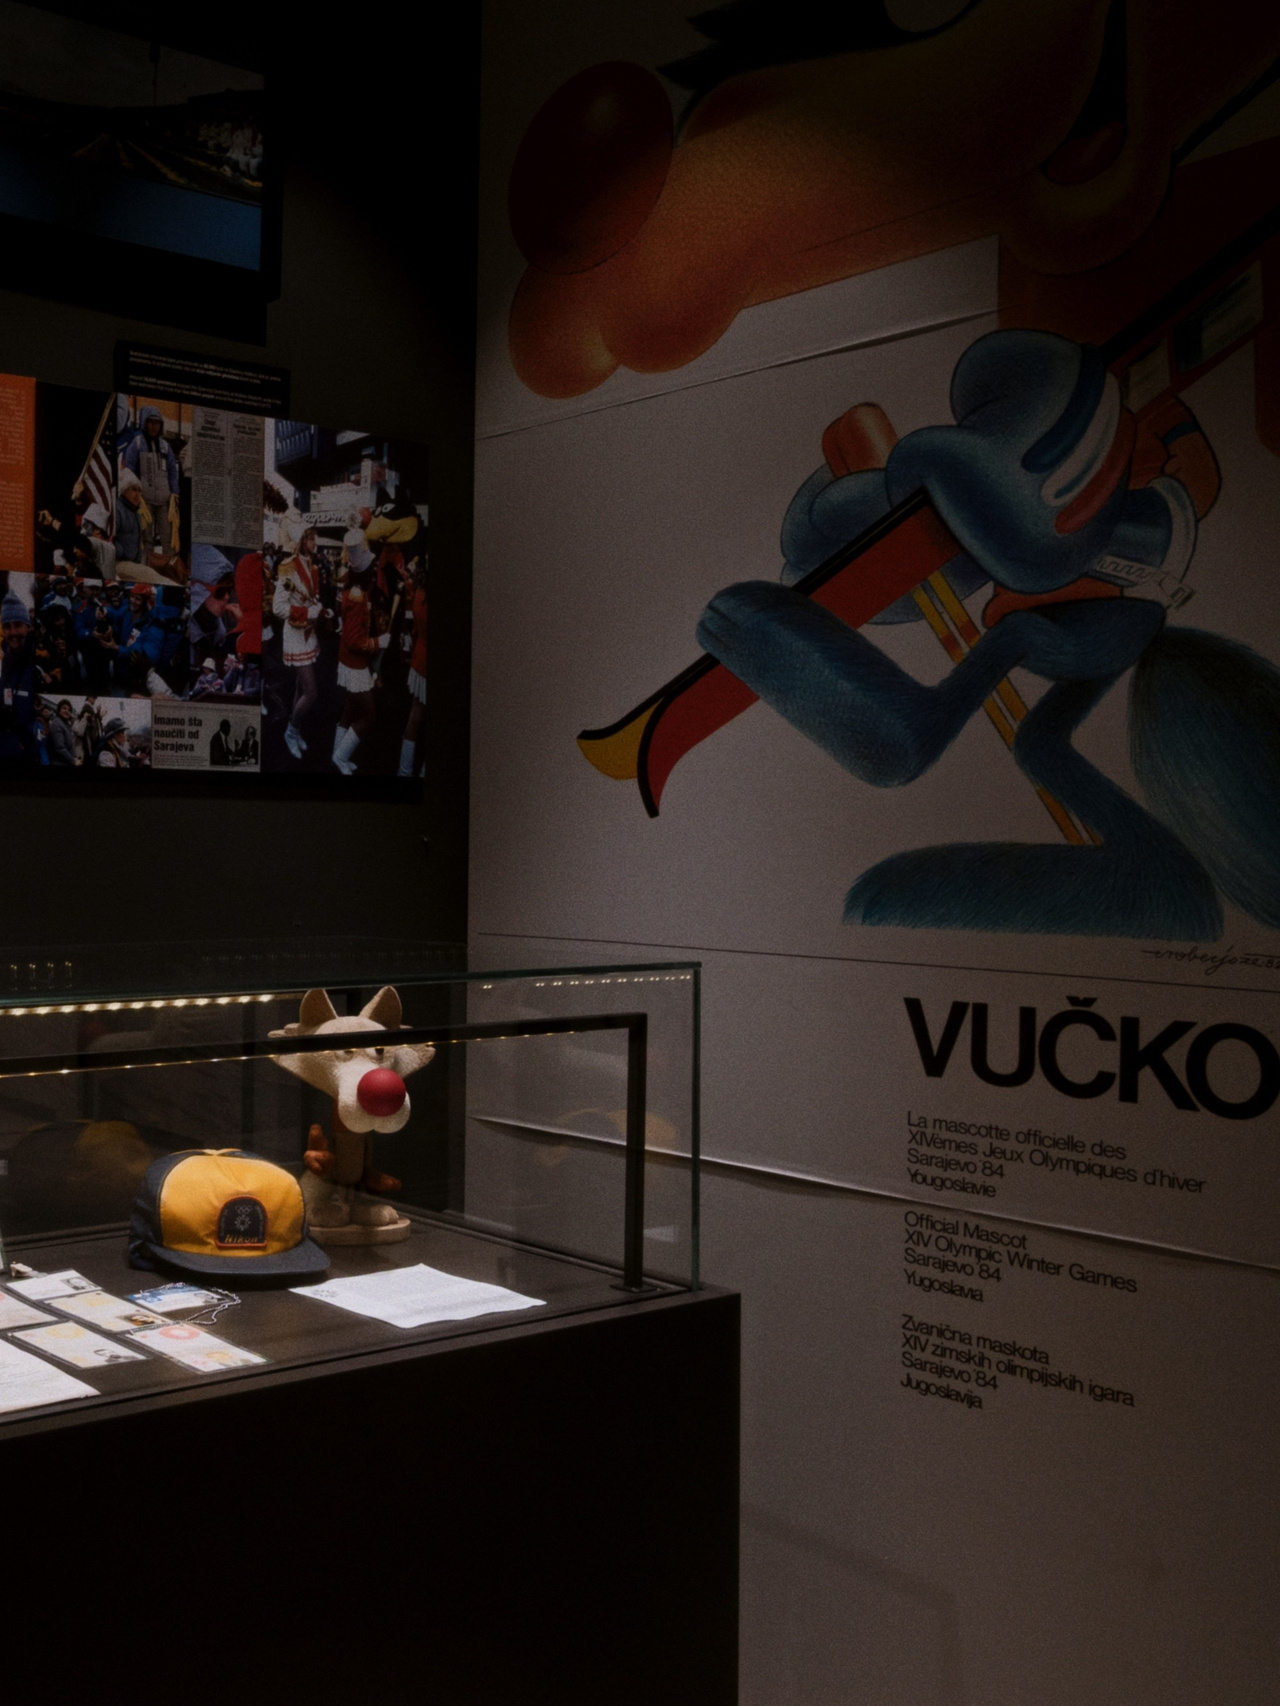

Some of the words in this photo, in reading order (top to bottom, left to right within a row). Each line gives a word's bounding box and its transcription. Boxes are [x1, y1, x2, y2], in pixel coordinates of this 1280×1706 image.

[154, 715, 185, 726] Imamo
[188, 729, 199, 739] od
[154, 741, 195, 753] Sarajeva
[903, 996, 1280, 1121] VUČKO
[907, 1110, 928, 1129] La
[933, 1117, 1010, 1141] mascotte
[1015, 1128, 1086, 1155] officielle
[1090, 1140, 1127, 1160] des
[907, 1148, 977, 1175] Sarajevo
[983, 1142, 1024, 1163] Jeux
[1029, 1148, 1137, 1183] Olympiques
[907, 1168, 997, 1198] Yougoslavie
[224, 1233, 258, 1243] Nikon
[904, 1210, 960, 1236] Official
[963, 1222, 1028, 1250] Mascot
[903, 1248, 975, 1276] Sarajevo
[904, 1229, 932, 1248] XIV
[934, 1236, 1003, 1264] Olympic
[1007, 1250, 1064, 1276] Winter
[1069, 1263, 1138, 1293] Games
[903, 1269, 984, 1302] Yugoslavia
[901, 1314, 973, 1345] Zvanična
[976, 1335, 1050, 1365] maskota
[901, 1353, 971, 1383] Sarajevo
[901, 1333, 930, 1352] XIV
[931, 1342, 992, 1370] zimskih
[996, 1358, 1084, 1394] olimpijskih
[1088, 1382, 1136, 1408] igara
[900, 1373, 984, 1409] Jugoslavija
